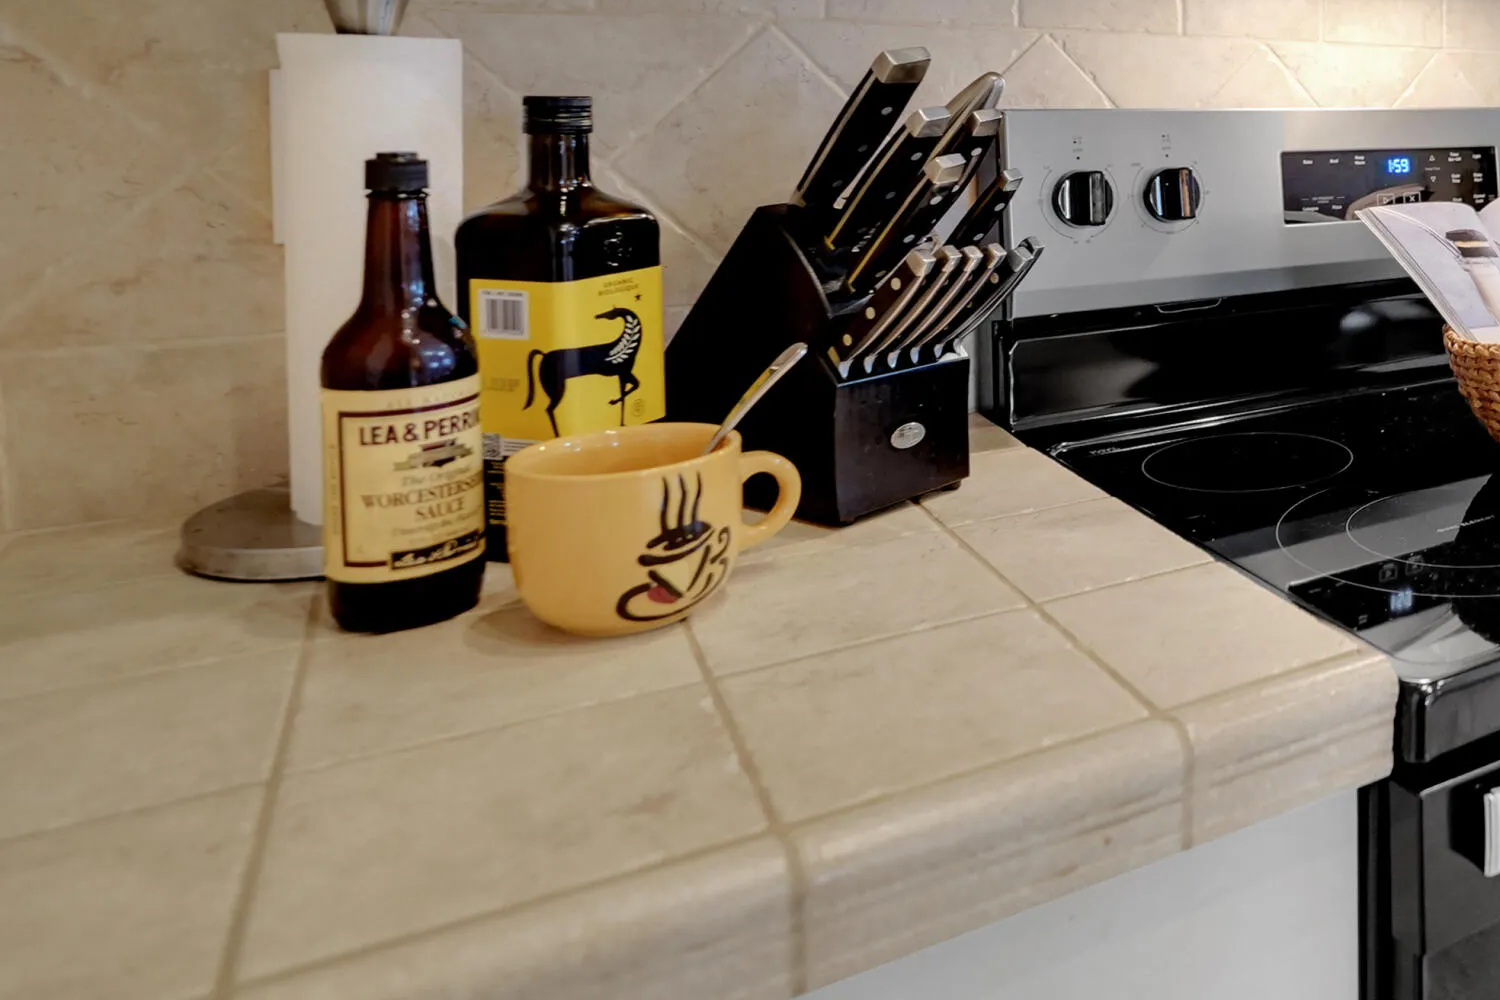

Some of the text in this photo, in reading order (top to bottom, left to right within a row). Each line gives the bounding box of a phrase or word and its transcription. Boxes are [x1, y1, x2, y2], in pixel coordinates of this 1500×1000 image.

[1387, 158, 1410, 173] 1:59
[359, 425, 398, 446] LEA
[403, 423, 418, 442] &
[416, 497, 465, 520] SAUCE
